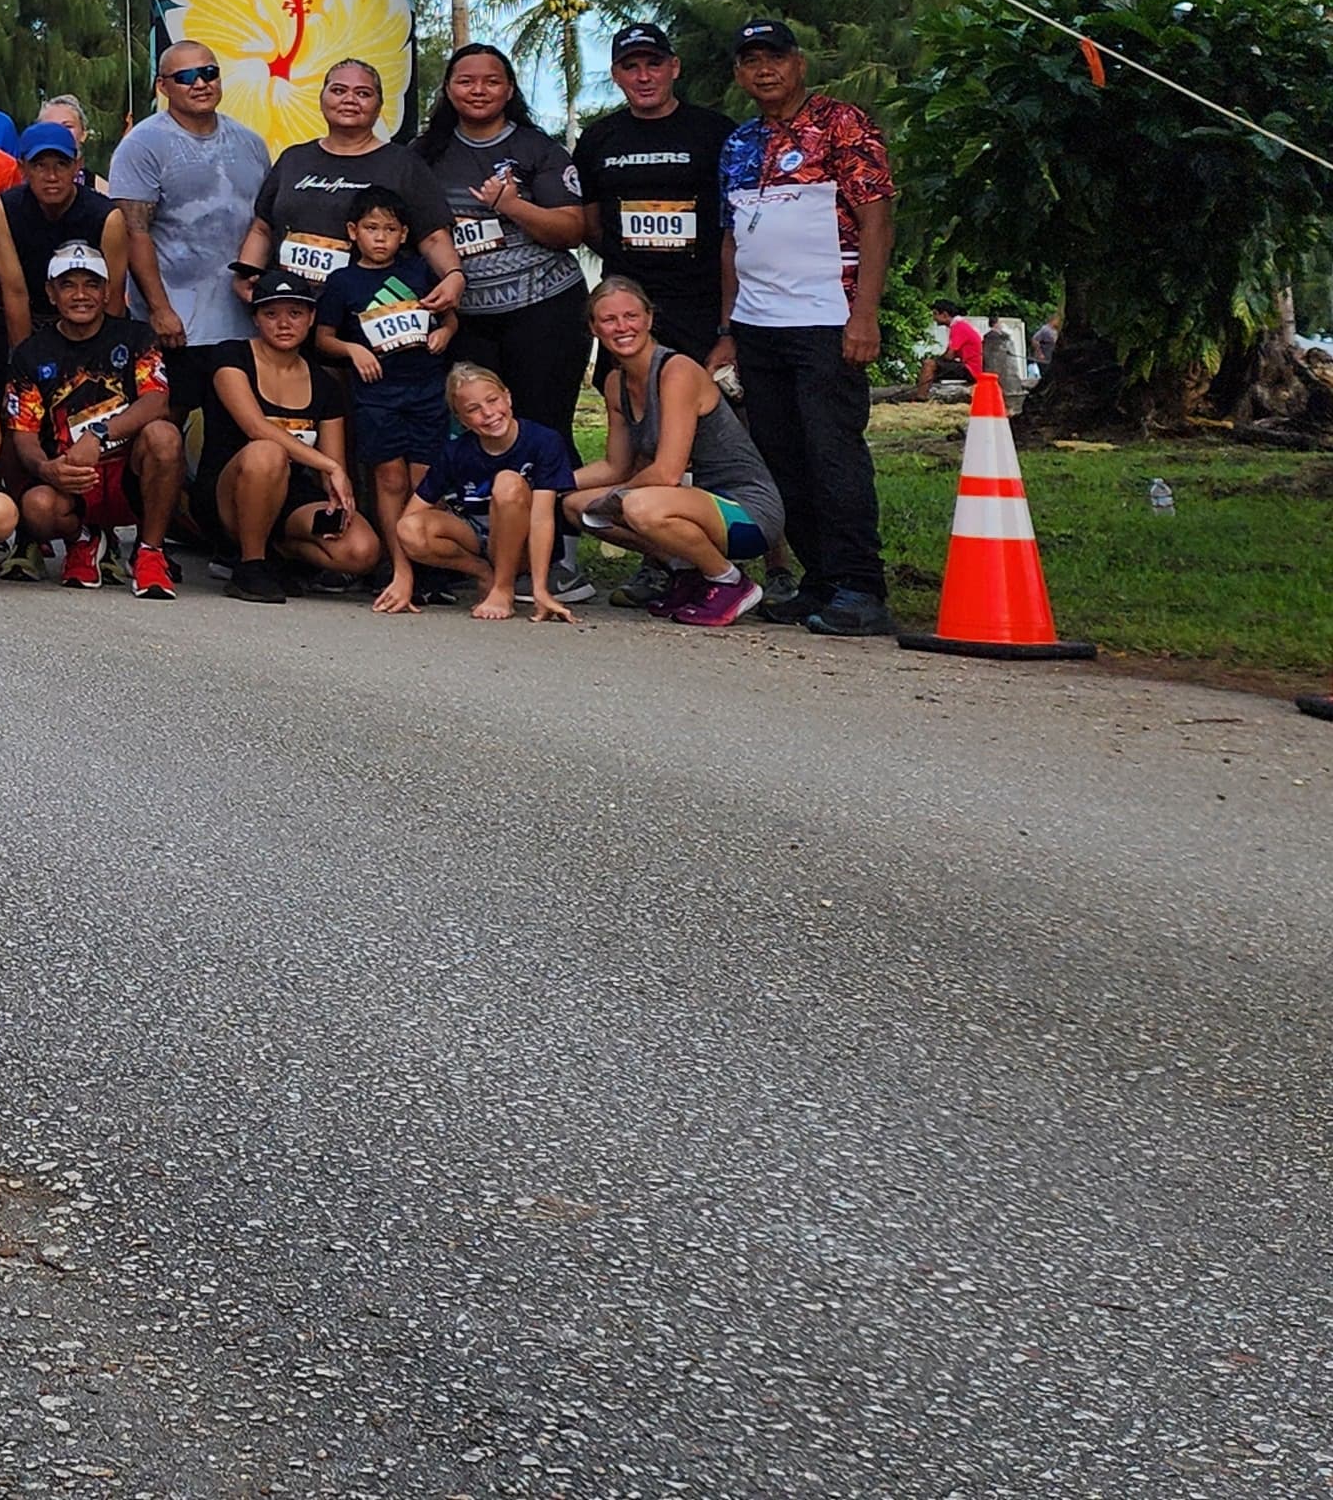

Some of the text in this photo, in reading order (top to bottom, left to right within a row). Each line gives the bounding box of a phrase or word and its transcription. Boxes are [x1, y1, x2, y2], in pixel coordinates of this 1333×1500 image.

[605, 152, 691, 168] RAIDERS
[630, 215, 682, 234] 0909
[291, 247, 333, 270] 1363
[375, 313, 421, 339] 1364
